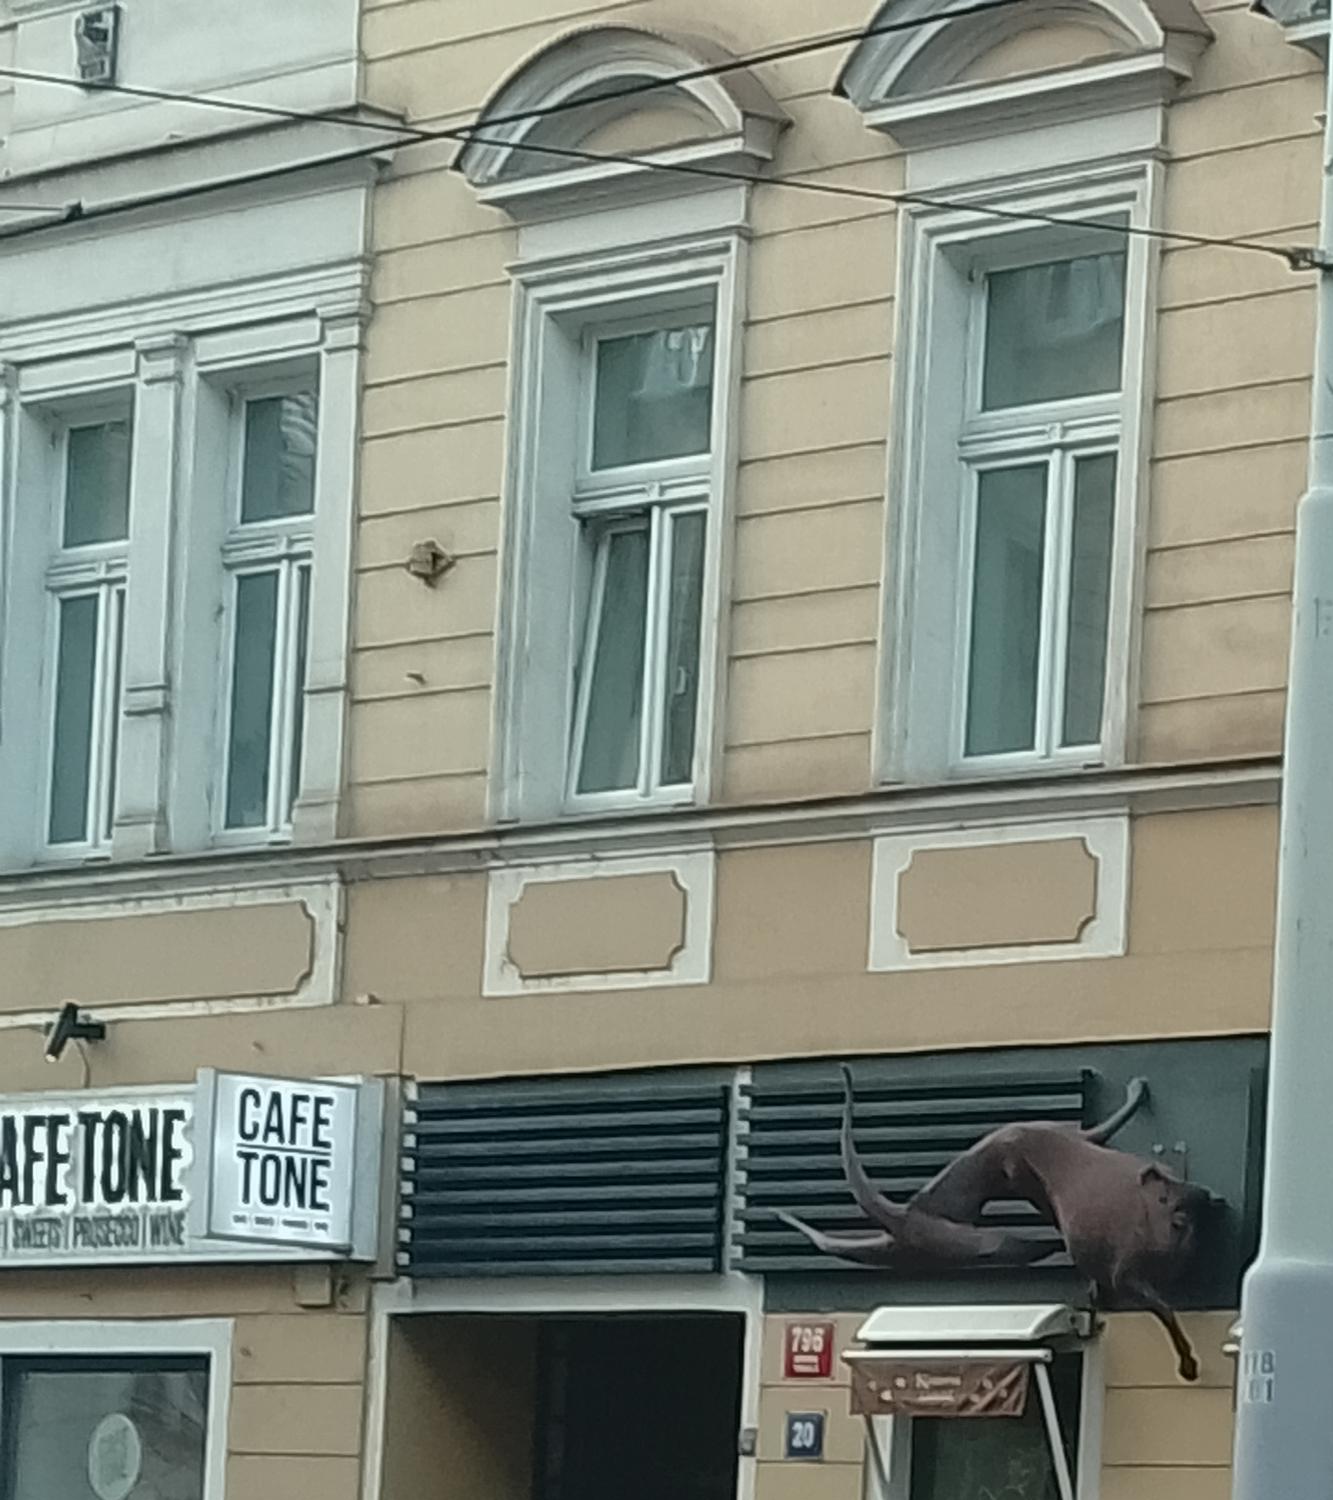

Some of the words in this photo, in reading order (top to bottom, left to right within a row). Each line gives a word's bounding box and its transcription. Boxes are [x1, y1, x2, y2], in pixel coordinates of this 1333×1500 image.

[238, 1088, 335, 1149] CAFE
[77, 1107, 187, 1203] TONE
[236, 1151, 332, 1212] TONE
[791, 1421, 815, 1448] 20
